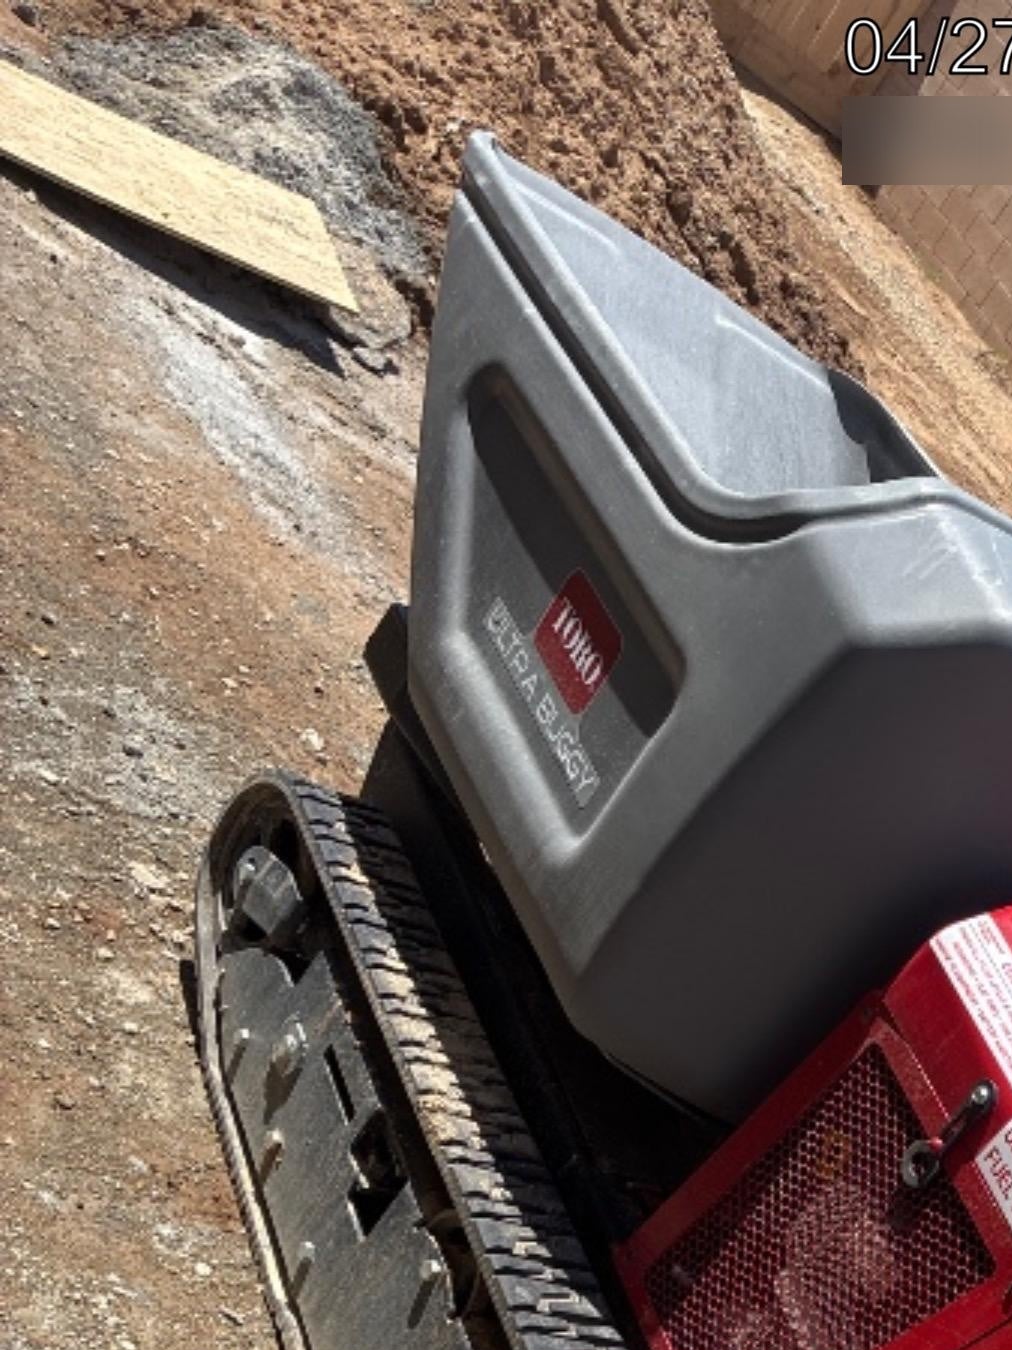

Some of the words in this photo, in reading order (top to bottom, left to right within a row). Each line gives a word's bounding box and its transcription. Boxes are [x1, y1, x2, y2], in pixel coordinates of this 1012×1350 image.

[485, 598, 537, 698] ULTRA
[536, 693, 597, 791] BUGGY
[551, 596, 601, 686] TORO
